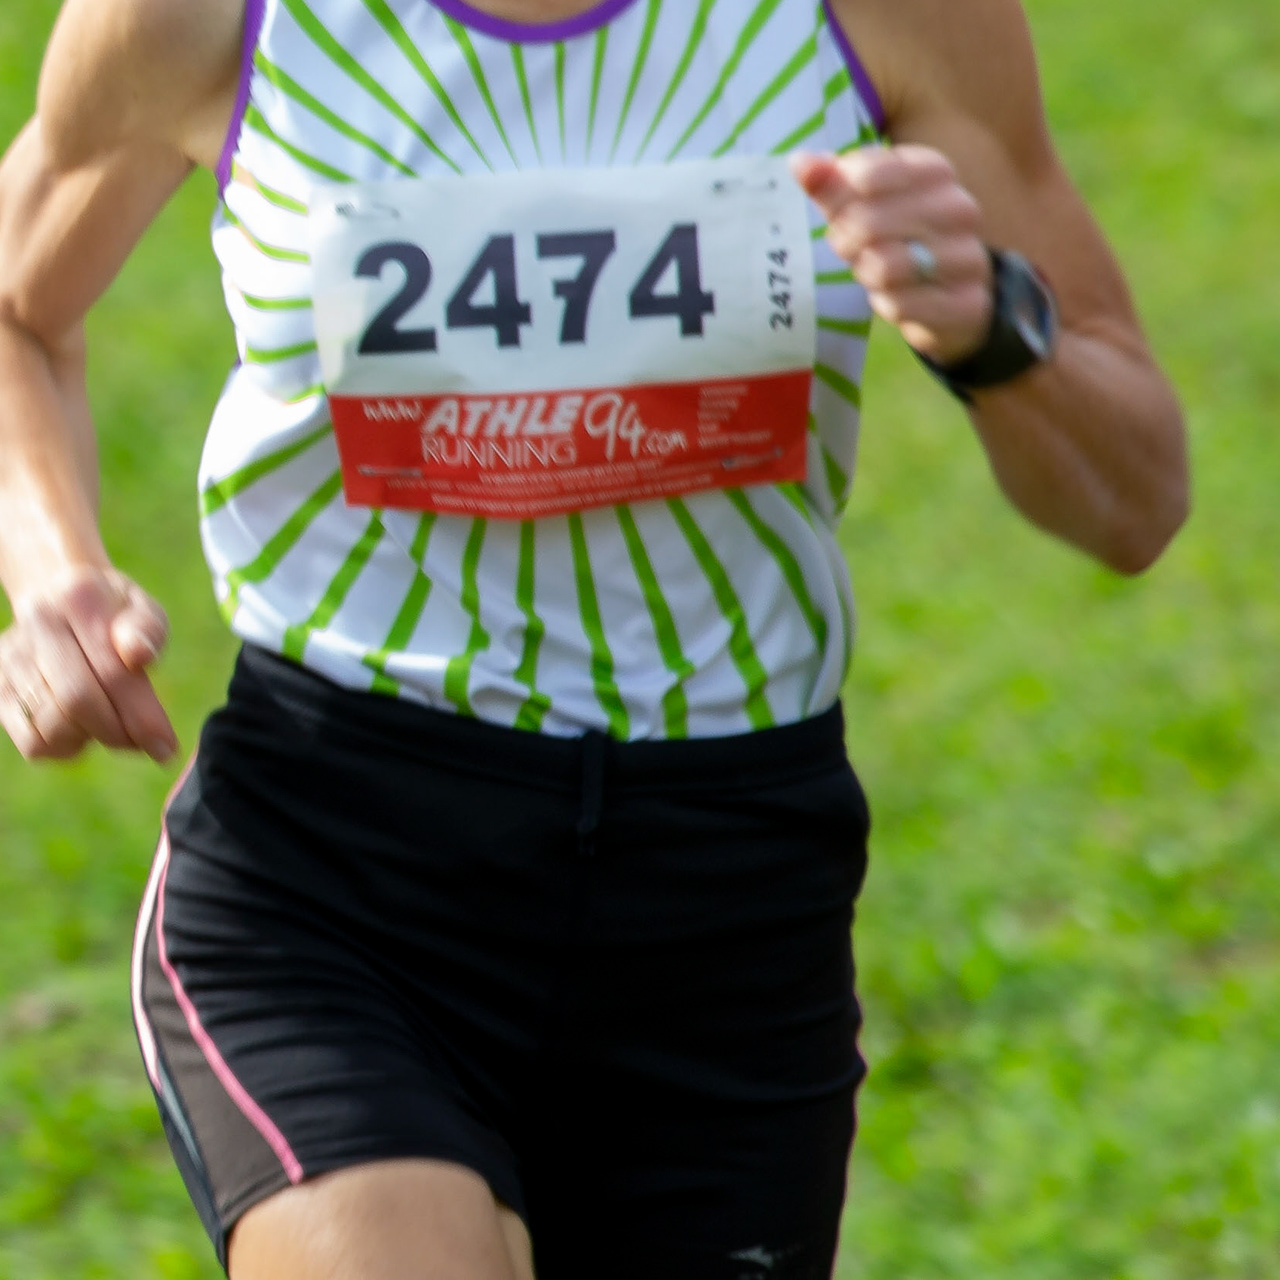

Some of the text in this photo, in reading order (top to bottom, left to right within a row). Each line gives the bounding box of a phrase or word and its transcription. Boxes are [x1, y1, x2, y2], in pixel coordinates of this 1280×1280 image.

[354, 222, 717, 357] 2474
[767, 248, 794, 331] 2474
[421, 433, 577, 469] RUNNING
